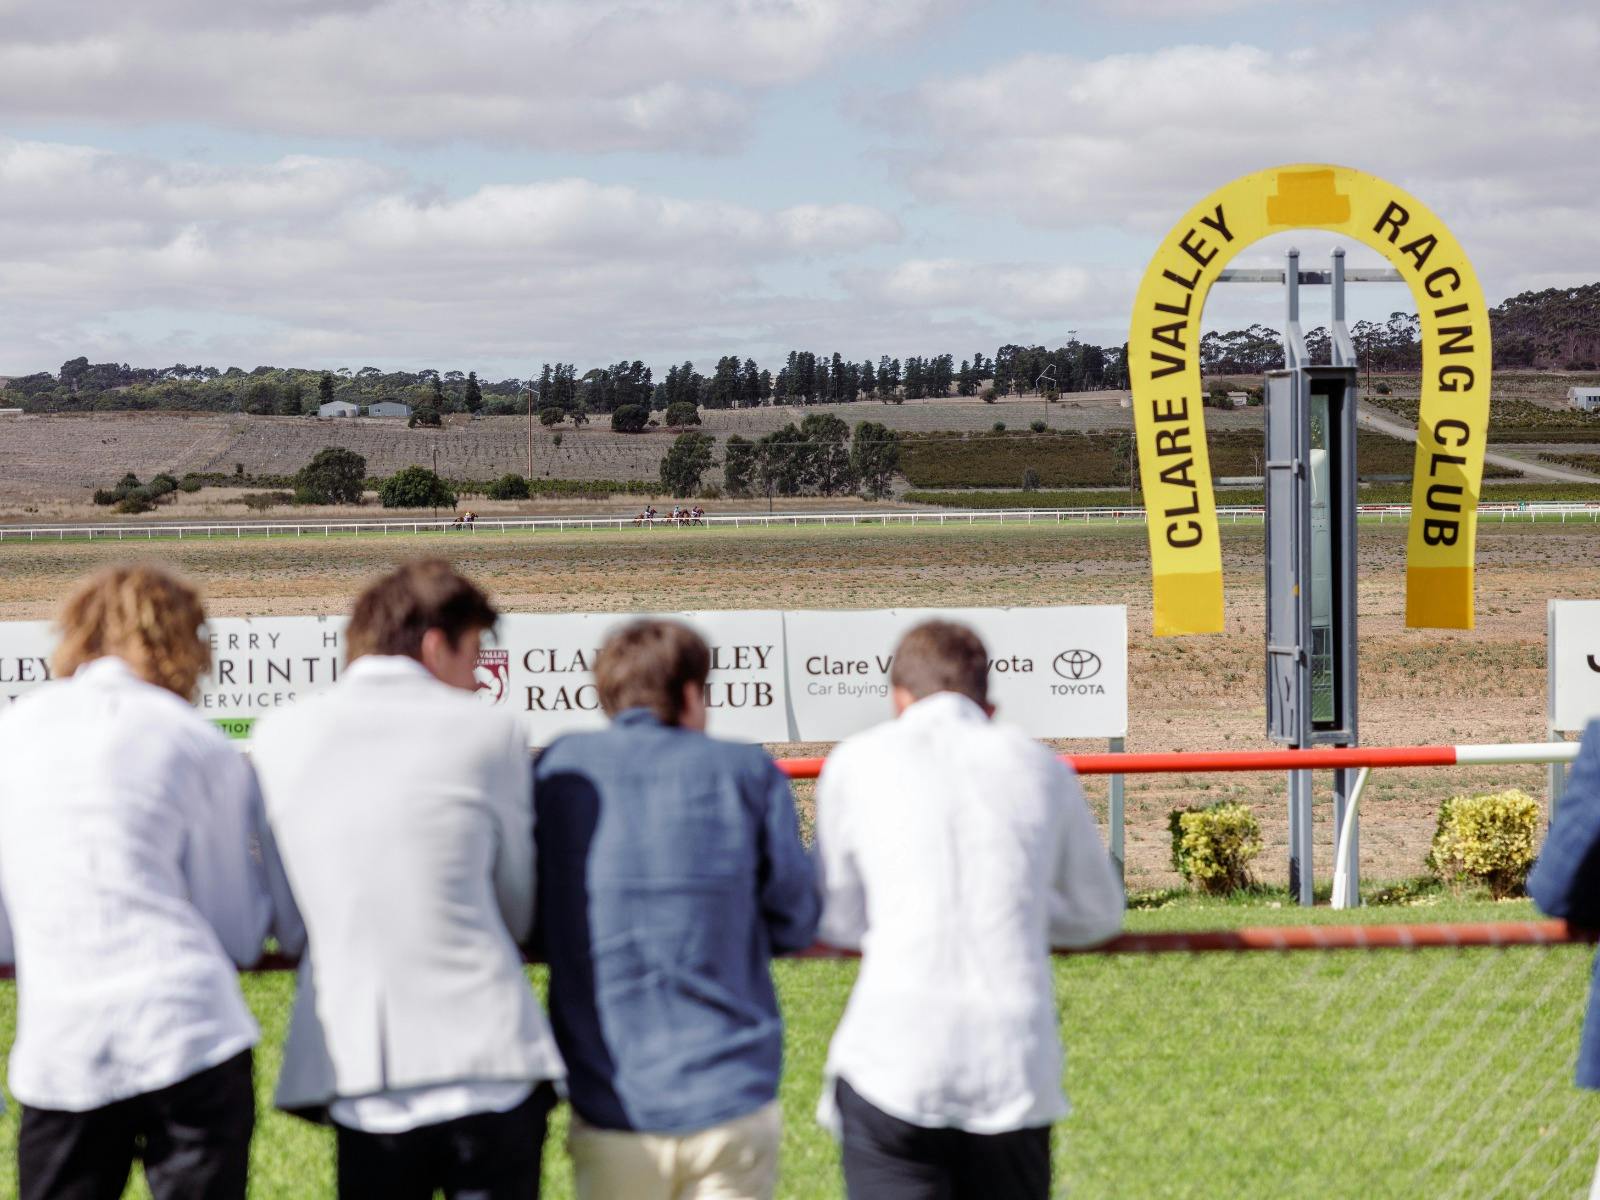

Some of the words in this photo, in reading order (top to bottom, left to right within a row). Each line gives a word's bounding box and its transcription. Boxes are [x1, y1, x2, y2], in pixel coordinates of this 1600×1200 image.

[1151, 204, 1235, 380] VALLEY
[1372, 200, 1475, 394] RACING
[1152, 396, 1203, 549] CLARE
[1423, 418, 1470, 548] CLUB
[523, 648, 600, 673] CLA
[806, 655, 869, 676] Clare
[194, 692, 297, 708] ERVICES
[524, 684, 602, 711] RAC
[705, 682, 774, 708] LUB
[808, 682, 832, 696] Car
[838, 682, 888, 697] Buying
[1050, 685, 1105, 696] TOYOTA
